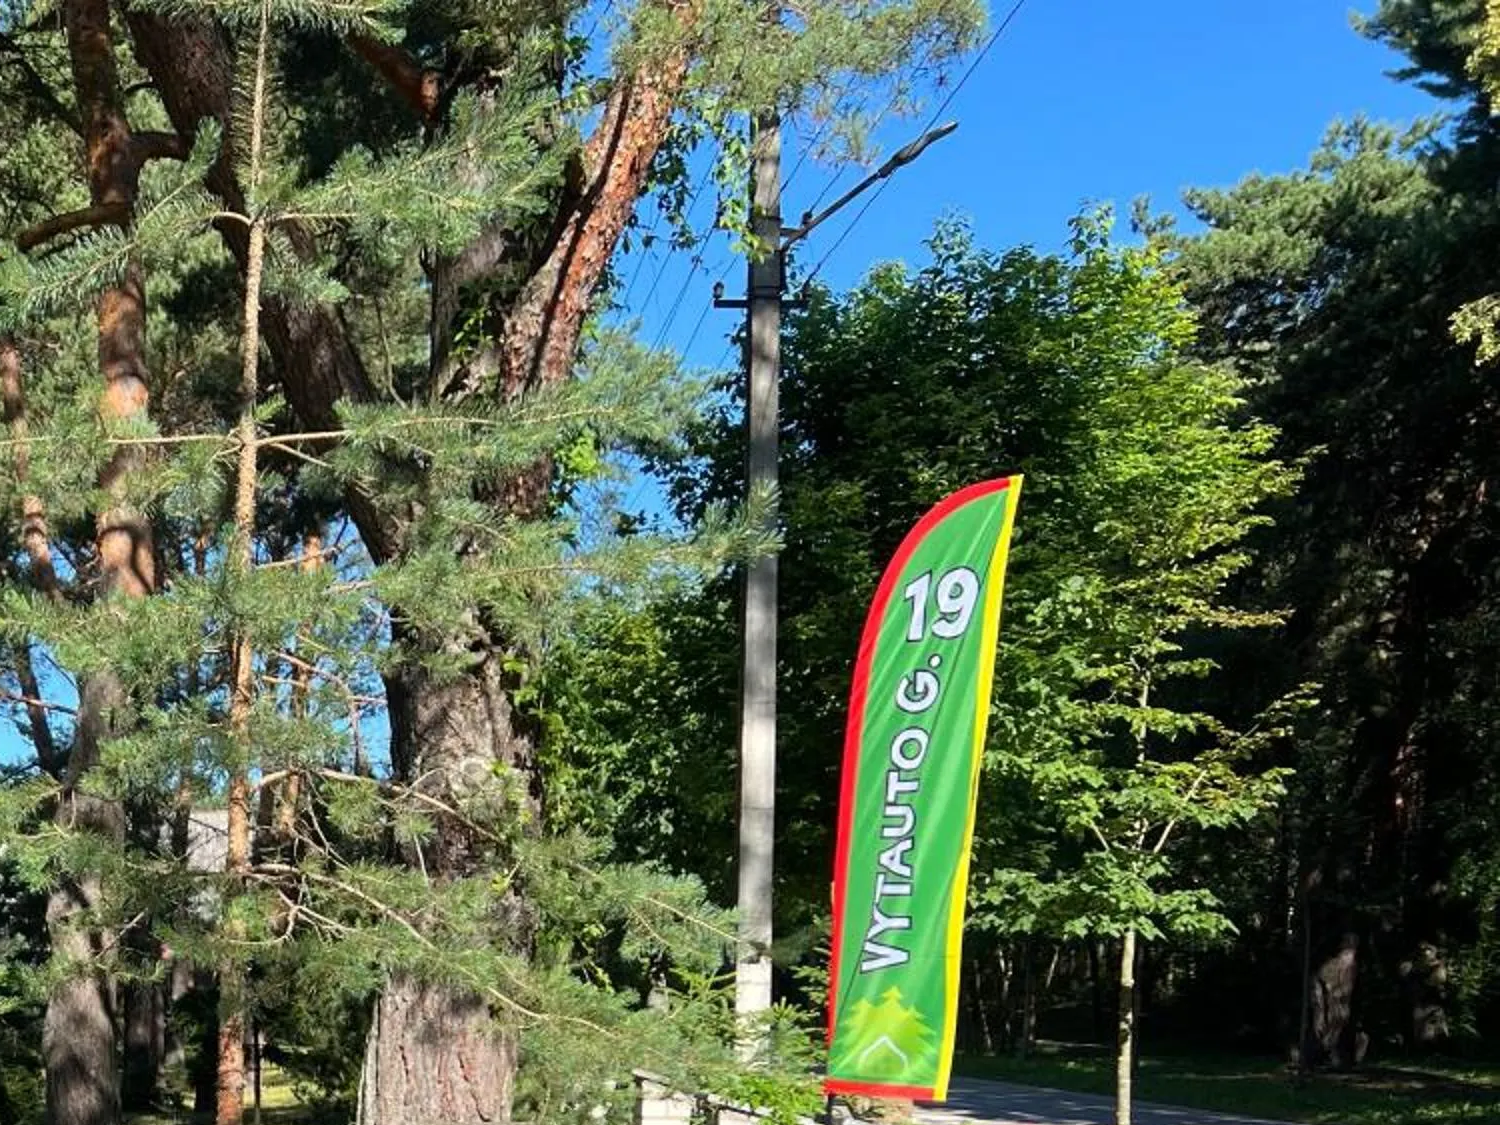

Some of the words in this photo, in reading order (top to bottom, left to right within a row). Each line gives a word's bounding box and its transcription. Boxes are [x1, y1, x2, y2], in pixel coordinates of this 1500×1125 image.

[904, 565, 980, 642] 19
[860, 726, 929, 973] VYTAUTO
[896, 654, 940, 714] G.
